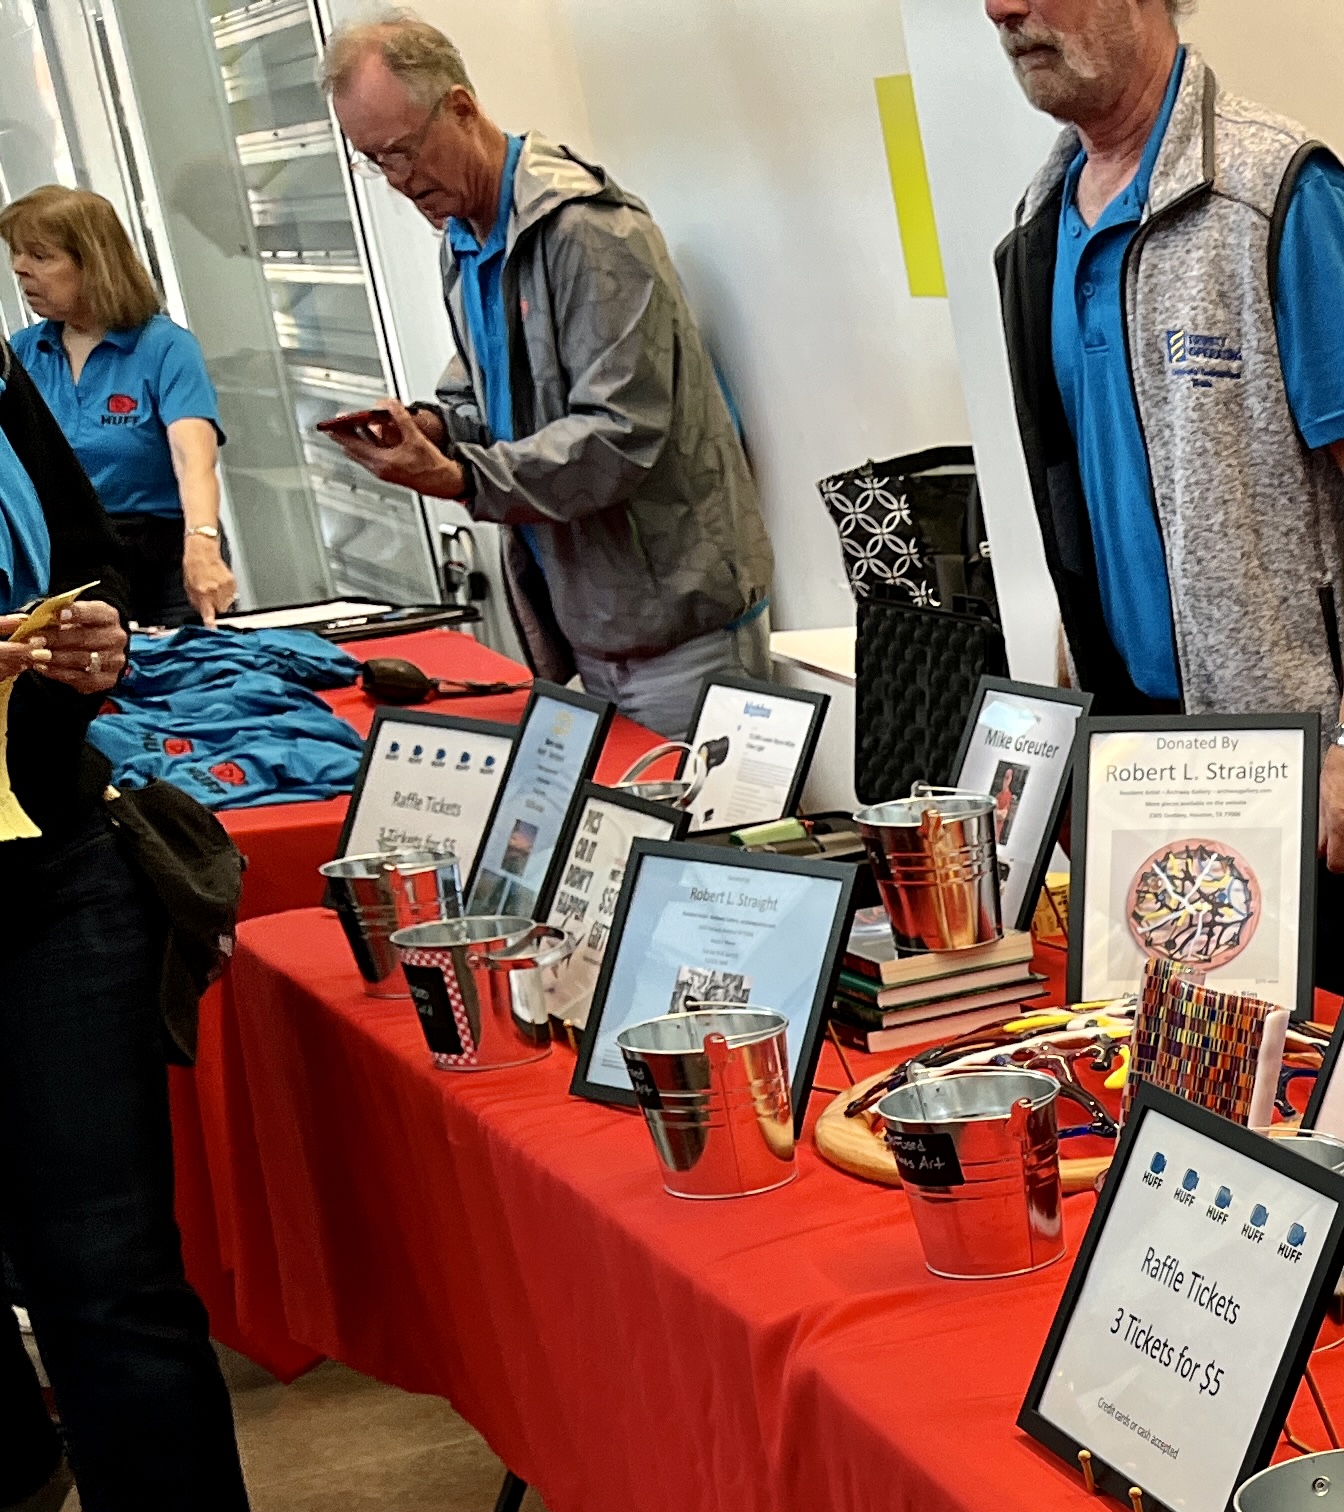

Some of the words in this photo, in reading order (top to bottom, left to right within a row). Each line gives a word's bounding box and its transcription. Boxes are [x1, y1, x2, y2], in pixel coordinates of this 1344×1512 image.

[984, 729, 1012, 750] Mike
[1014, 735, 1060, 759] Greuter
[1156, 737, 1217, 750] Donated
[1221, 736, 1239, 751] By
[1105, 762, 1176, 783] Robert
[1183, 763, 1199, 781] L.
[1206, 760, 1289, 784] Straight
[393, 791, 423, 811] Raffle
[425, 796, 462, 817] Tickets
[689, 887, 724, 904] Robert
[738, 892, 778, 913] Straight
[1142, 1171, 1163, 1189] HUFF
[1174, 1188, 1195, 1207] HUFF
[1206, 1205, 1229, 1225] HUFF
[1241, 1223, 1264, 1243] HUFF
[1277, 1242, 1302, 1263] HUFF
[1141, 1247, 1185, 1293] Raffle
[1187, 1270, 1240, 1325] Tickets
[1110, 1307, 1122, 1334] 3
[1124, 1314, 1174, 1369] Tickets
[1175, 1342, 1200, 1384] for
[1199, 1362, 1225, 1397] $5
[1098, 1397, 1115, 1417] Credit
[1115, 1410, 1131, 1427] cards
[1137, 1426, 1151, 1441] cash
[1151, 1435, 1180, 1459] accepted
